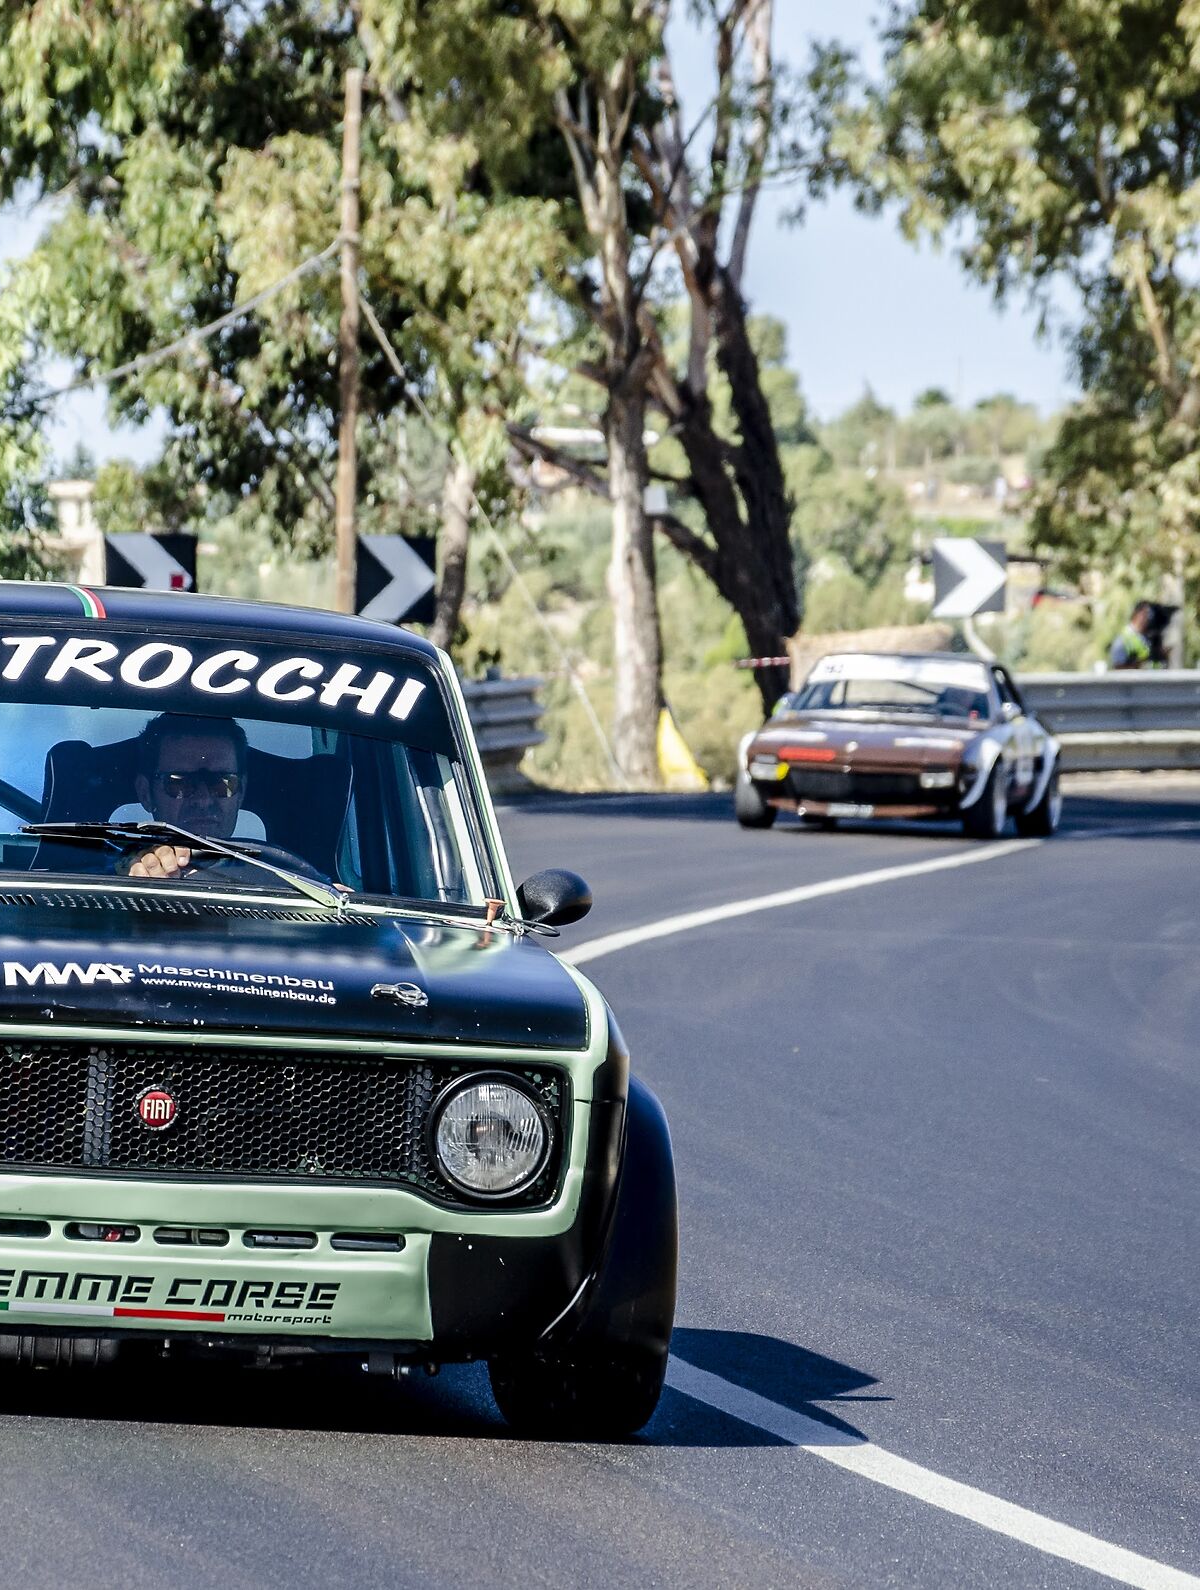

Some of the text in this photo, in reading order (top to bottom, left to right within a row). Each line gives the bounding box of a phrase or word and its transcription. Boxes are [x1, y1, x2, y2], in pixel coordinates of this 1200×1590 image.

[3, 961, 335, 991] MWA Maschinenbau
[140, 977, 337, 1005] www.mwa-maschinenbau.de
[143, 1099, 173, 1120] FIAT
[164, 1278, 342, 1310] CORSE
[227, 1312, 332, 1325] motorsport
